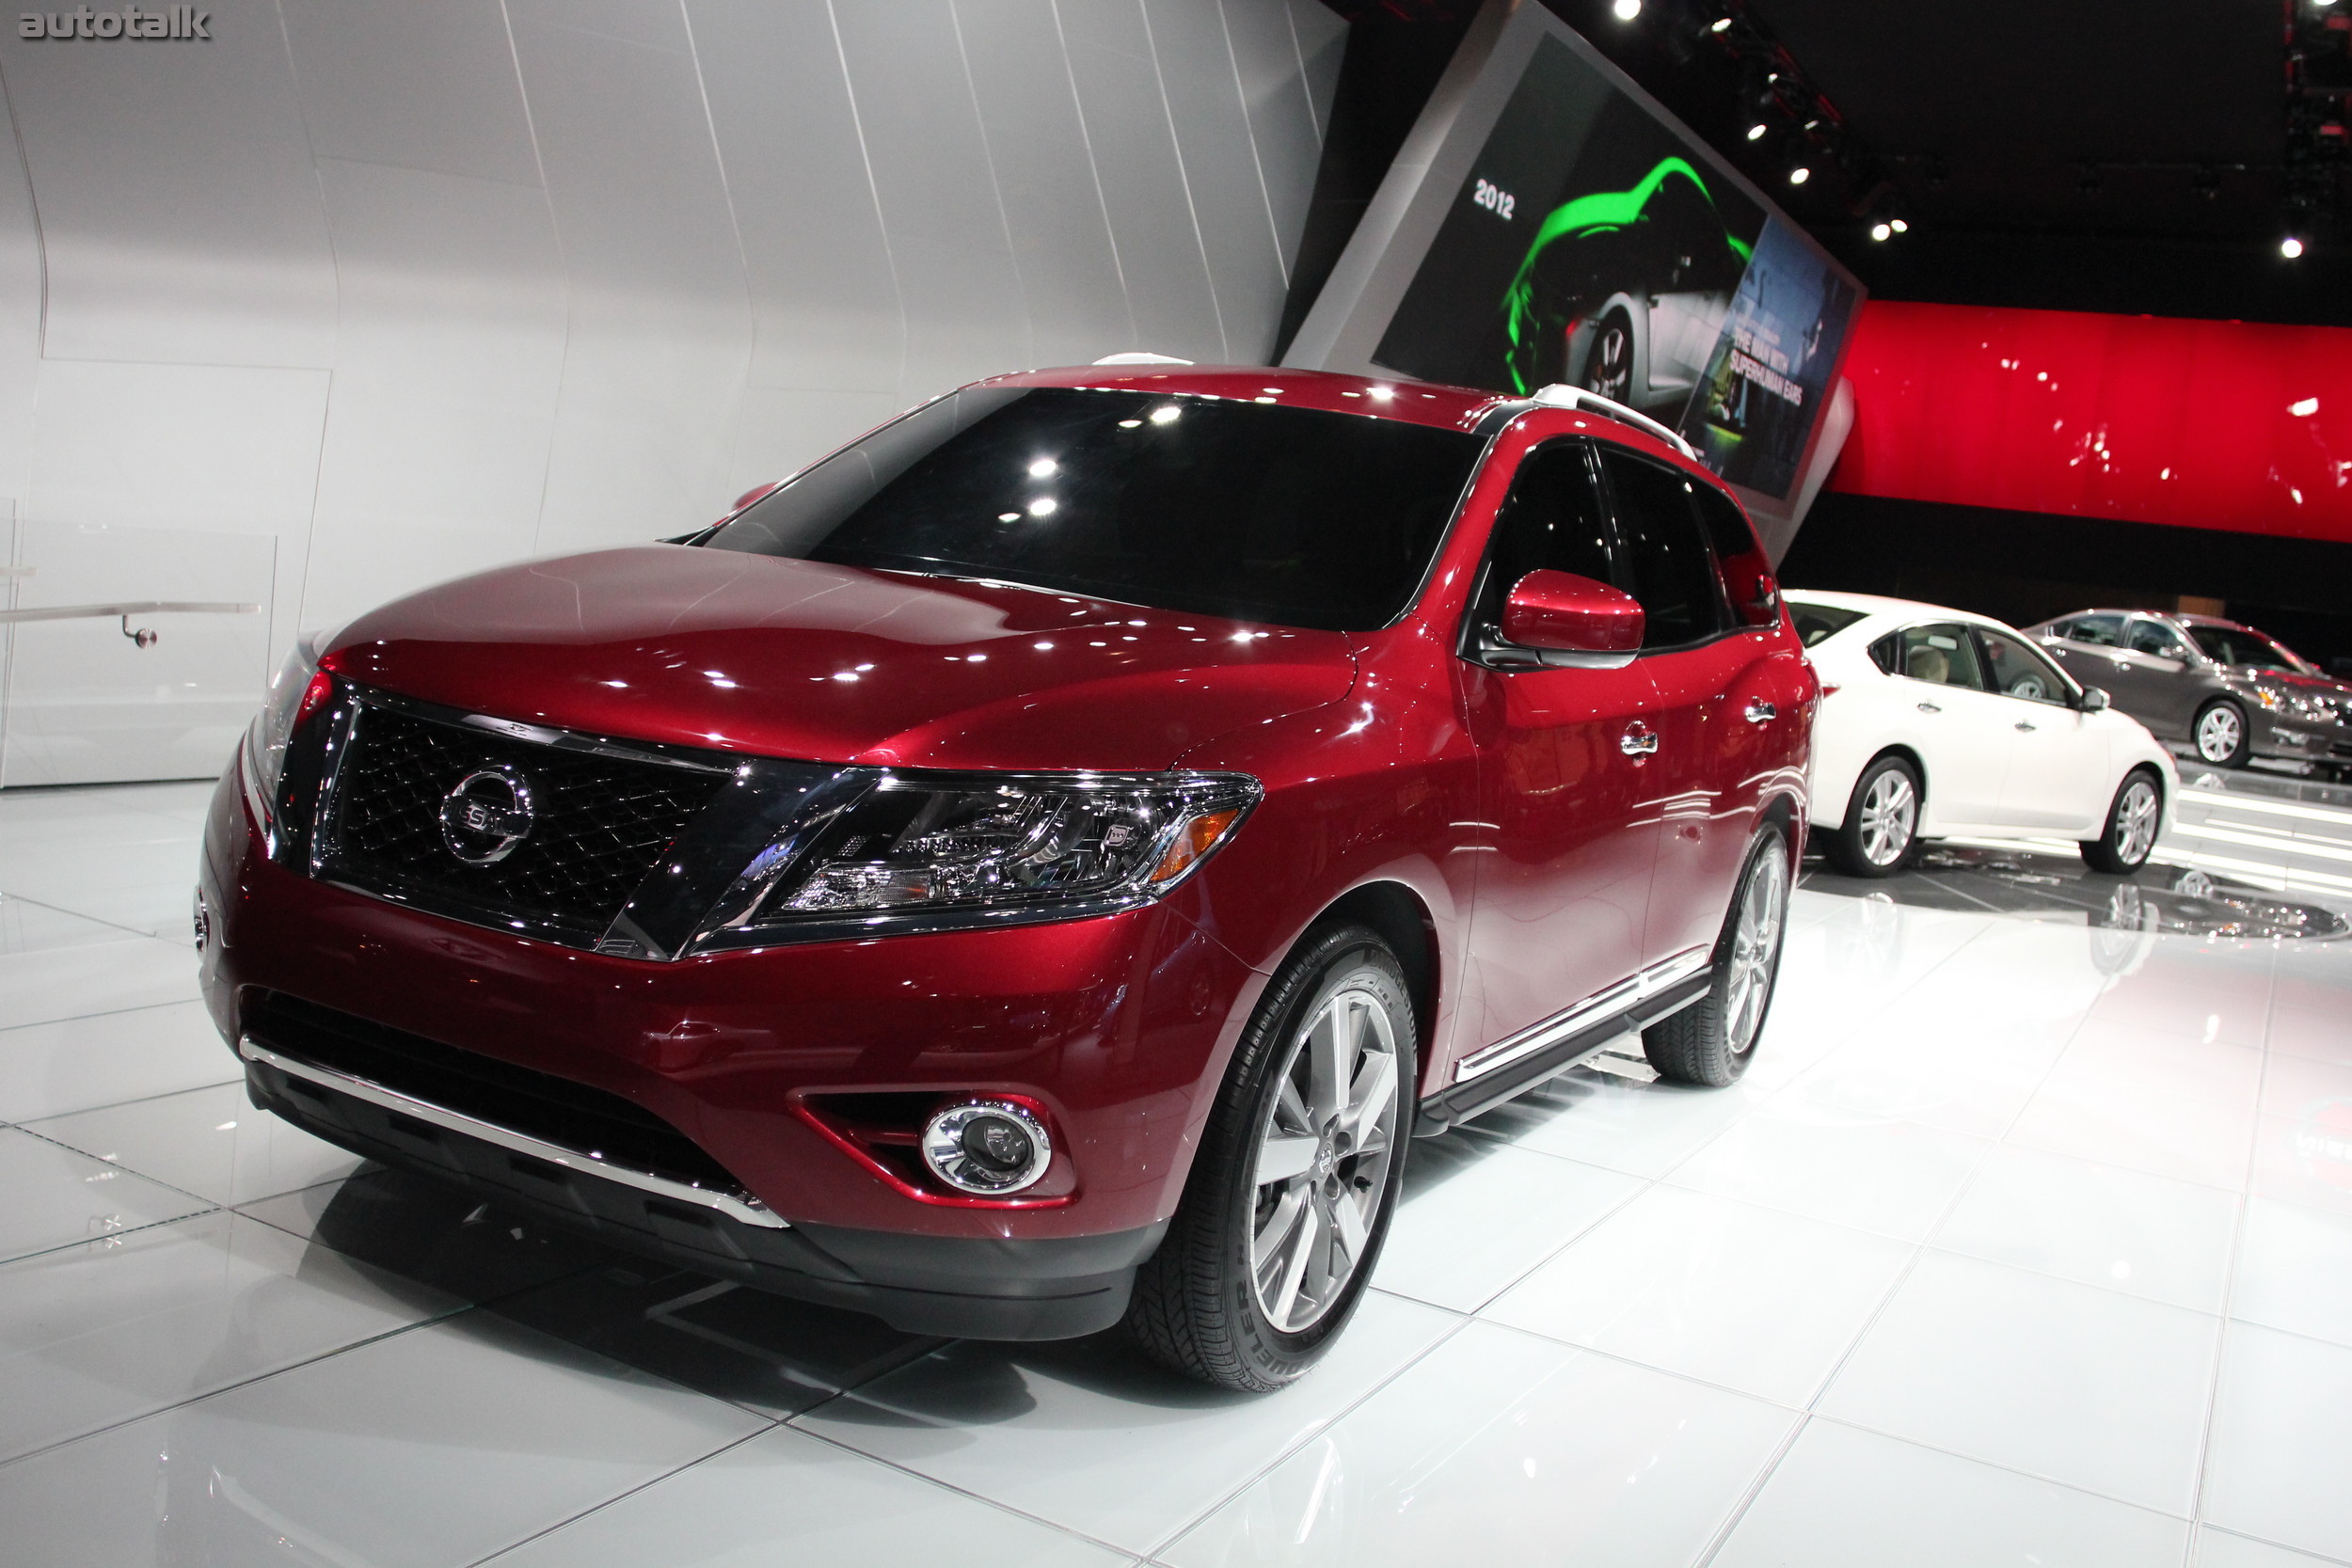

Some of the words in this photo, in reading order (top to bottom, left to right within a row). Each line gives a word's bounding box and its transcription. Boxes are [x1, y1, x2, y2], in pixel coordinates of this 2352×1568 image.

[1474, 179, 1515, 220] 2012
[1730, 349, 1785, 396] SUPERHUMAN
[1783, 379, 1804, 405] EARS
